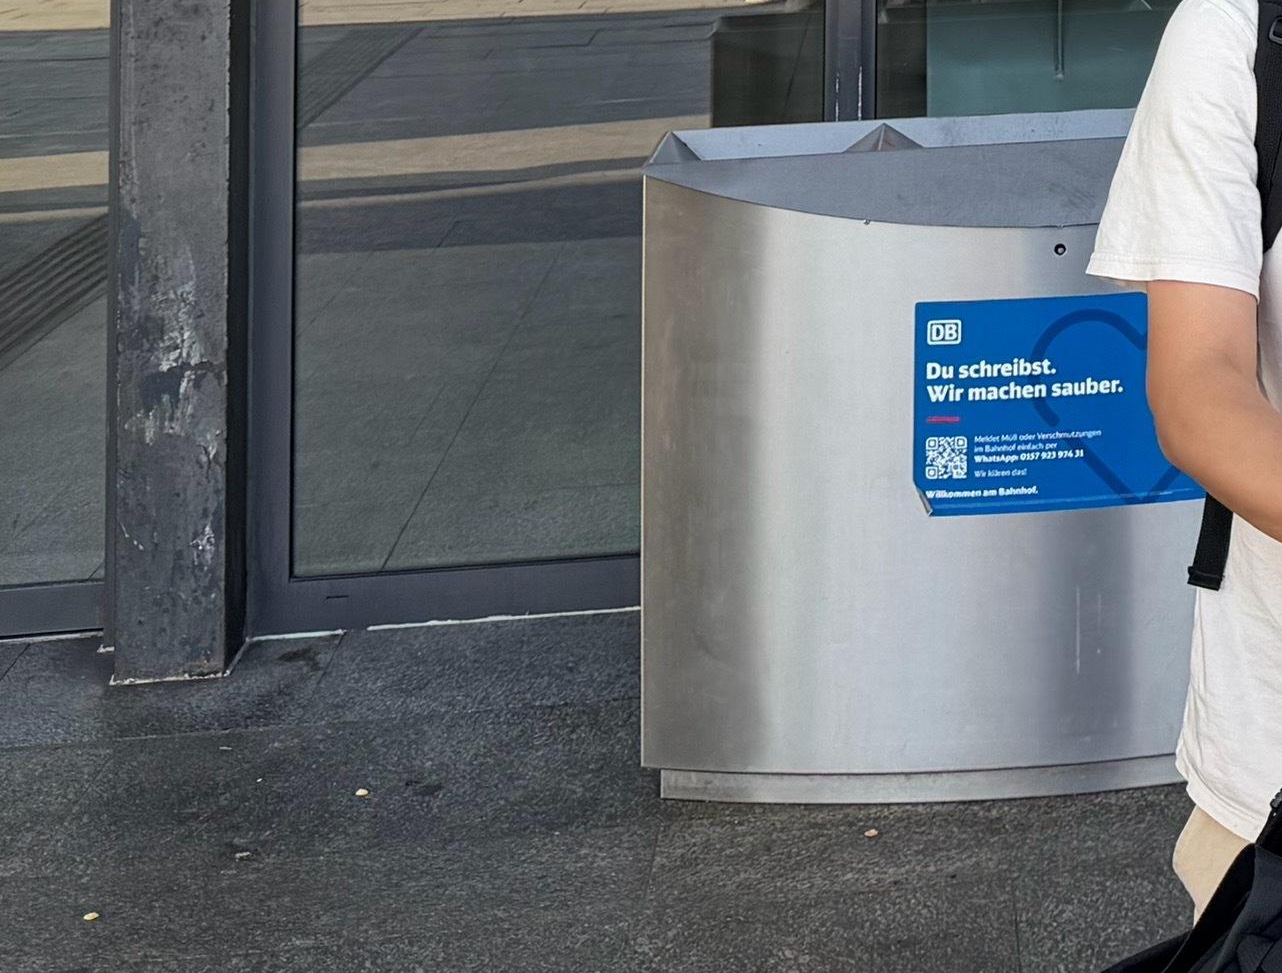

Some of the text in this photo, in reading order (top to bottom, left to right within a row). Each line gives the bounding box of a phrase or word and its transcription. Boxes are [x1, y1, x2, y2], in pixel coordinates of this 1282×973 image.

[930, 322, 959, 343] DB
[926, 358, 1057, 380] Du schreibst.
[927, 377, 1124, 402] Wir machen sauber.
[974, 435, 1000, 444] Meldet
[1019, 433, 1036, 441] oder
[985, 443, 1016, 453] Bahnhof
[1017, 442, 1044, 451] einfach
[1045, 441, 1058, 451] per
[974, 453, 1019, 464] WhatsApp:
[926, 485, 1039, 499] Willkommen am Bahnhof.
